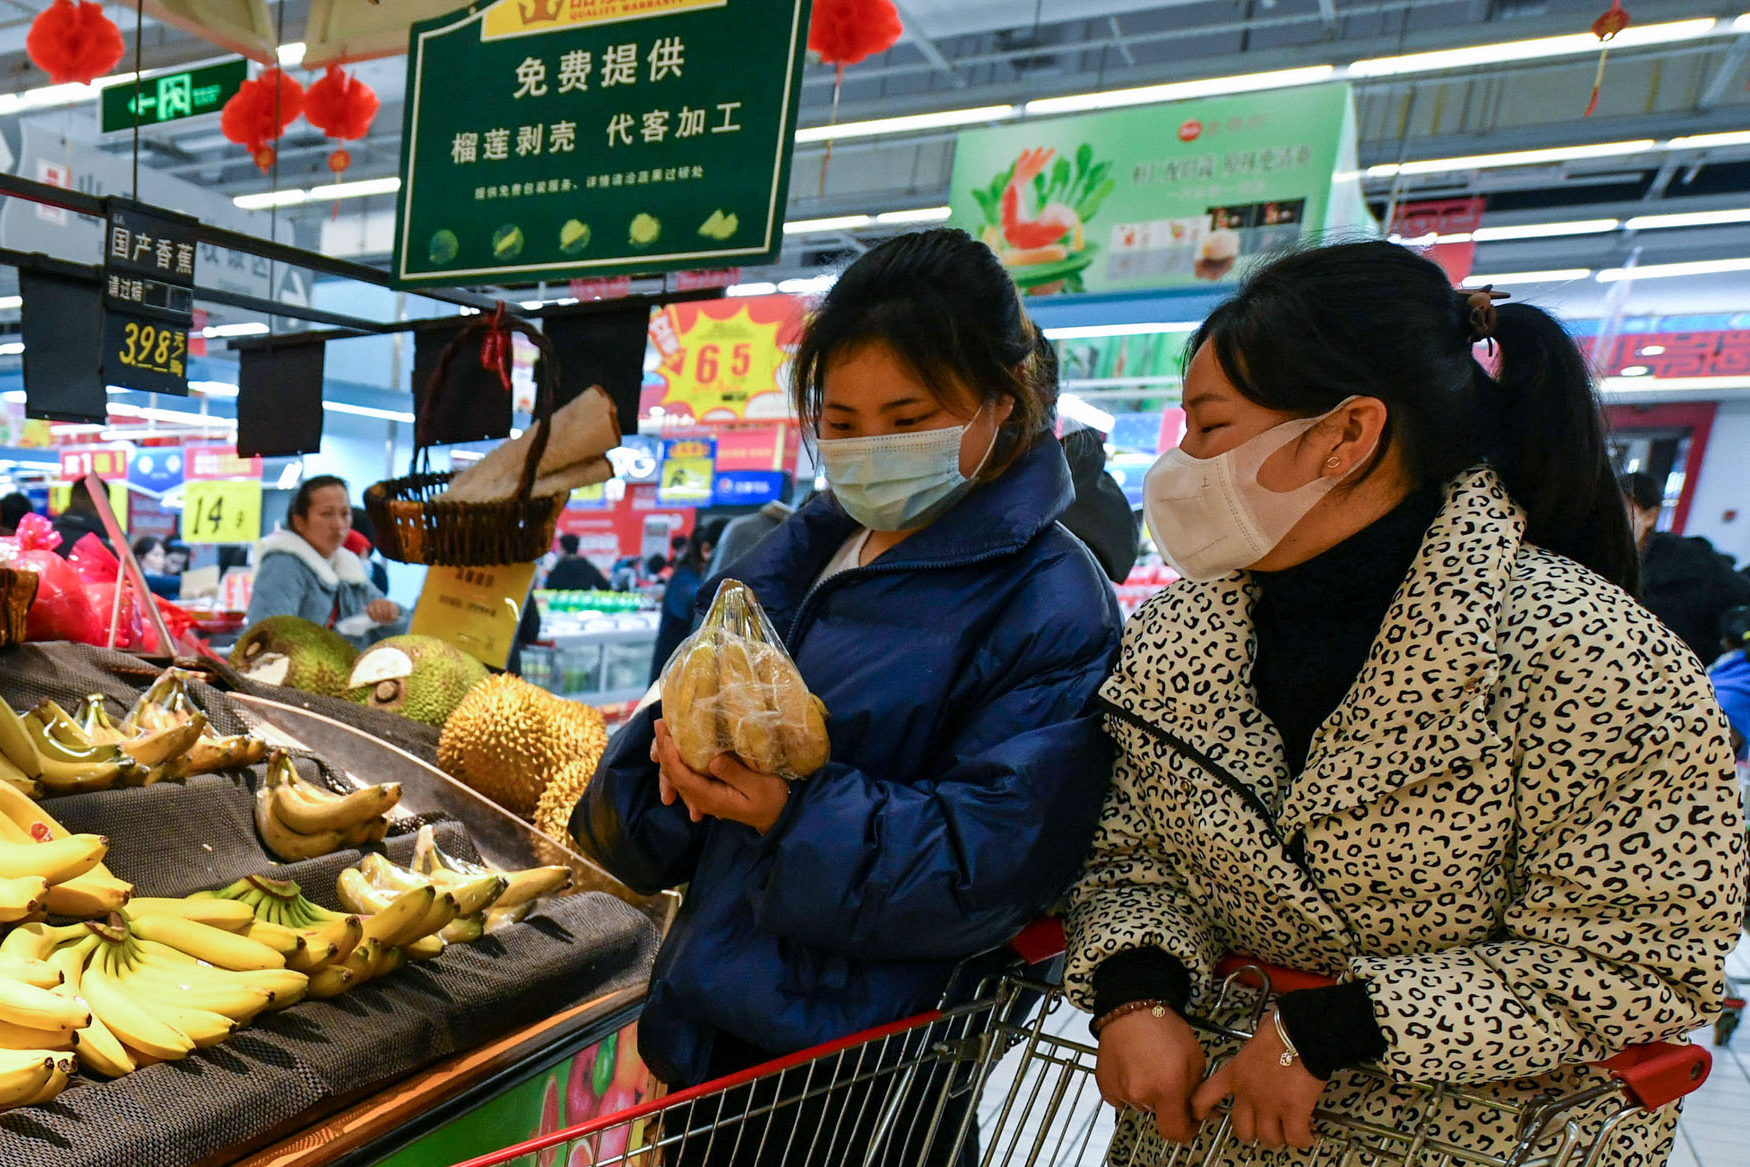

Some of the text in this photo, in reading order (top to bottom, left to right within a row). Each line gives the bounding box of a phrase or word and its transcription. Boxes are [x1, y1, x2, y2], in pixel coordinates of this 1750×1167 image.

[512, 35, 686, 99] 免费提供
[451, 102, 743, 164] 榴莲剥壳 代客加工
[111, 226, 194, 275] 国产香蕉
[107, 274, 143, 302] 请过磅
